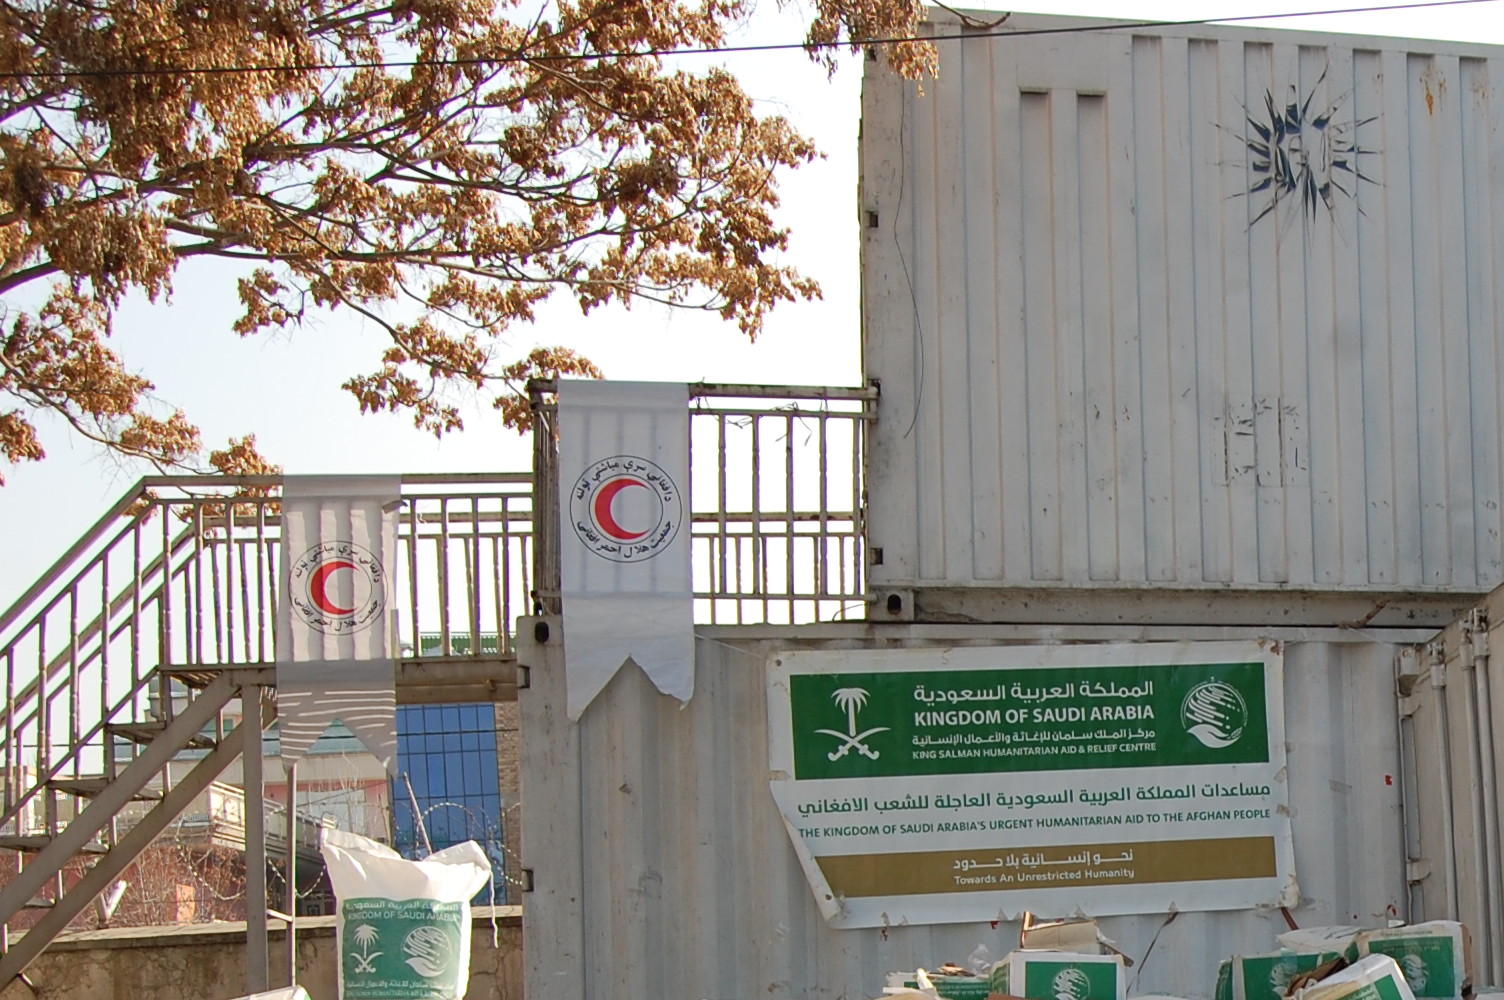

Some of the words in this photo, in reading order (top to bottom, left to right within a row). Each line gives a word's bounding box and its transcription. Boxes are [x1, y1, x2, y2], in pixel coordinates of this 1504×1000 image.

[623, 544, 650, 558] هلال
[912, 683, 1007, 707] السعودية
[1009, 681, 1075, 704] العربية
[1078, 679, 1154, 699] المملكة
[913, 708, 1002, 727] KINGDOM
[1004, 707, 1029, 724] OF
[1031, 706, 1086, 724] SAUDI
[1089, 703, 1155, 722] ARABIA
[910, 732, 964, 747] الإنسانية
[962, 730, 1012, 745] والأعمال
[1011, 729, 1051, 744] للإغاثة
[1050, 729, 1094, 743] سلمان
[1092, 727, 1127, 740] الملك
[1126, 726, 1157, 740] مركز
[911, 749, 938, 760] KING
[937, 747, 982, 759] SALMAN
[981, 745, 1060, 758] HUMANITARIAN
[1059, 744, 1078, 755] AID
[1076, 744, 1086, 754] &
[1086, 742, 1118, 754] RELIEF
[1117, 741, 1157, 753] CENTRE
[995, 787, 1074, 810] السعودية
[1078, 786, 1132, 807] العربية
[1134, 783, 1196, 801] المملكة
[1200, 781, 1271, 798] مساعدات
[796, 796, 869, 819] الافغاني
[873, 792, 930, 816] للشعب
[933, 791, 992, 812] العاجلة
[796, 826, 821, 839] THE
[822, 824, 880, 838] KINGDOM
[881, 823, 897, 835] OF
[898, 822, 934, 835] SAUDI
[935, 819, 987, 833] ARABIA'S
[988, 817, 1034, 831] URGENT
[1035, 814, 1123, 829] HUMANITARIAN
[1124, 813, 1145, 825] AID
[1145, 812, 1161, 824] TO
[1161, 811, 1184, 823] THE
[1184, 809, 1232, 822] AFGHAN
[1232, 807, 1271, 820] PEOPLE
[952, 856, 1004, 872] حدود
[1004, 852, 1020, 870] بلا
[1020, 849, 1091, 869] إنسانية
[1091, 847, 1134, 866] نحو
[952, 873, 997, 886] Towards
[998, 872, 1015, 884] An
[1016, 869, 1082, 883] Unrestricted
[1083, 866, 1135, 879] Humanity
[384, 911, 397, 919] OF
[397, 911, 425, 920] SAUDI
